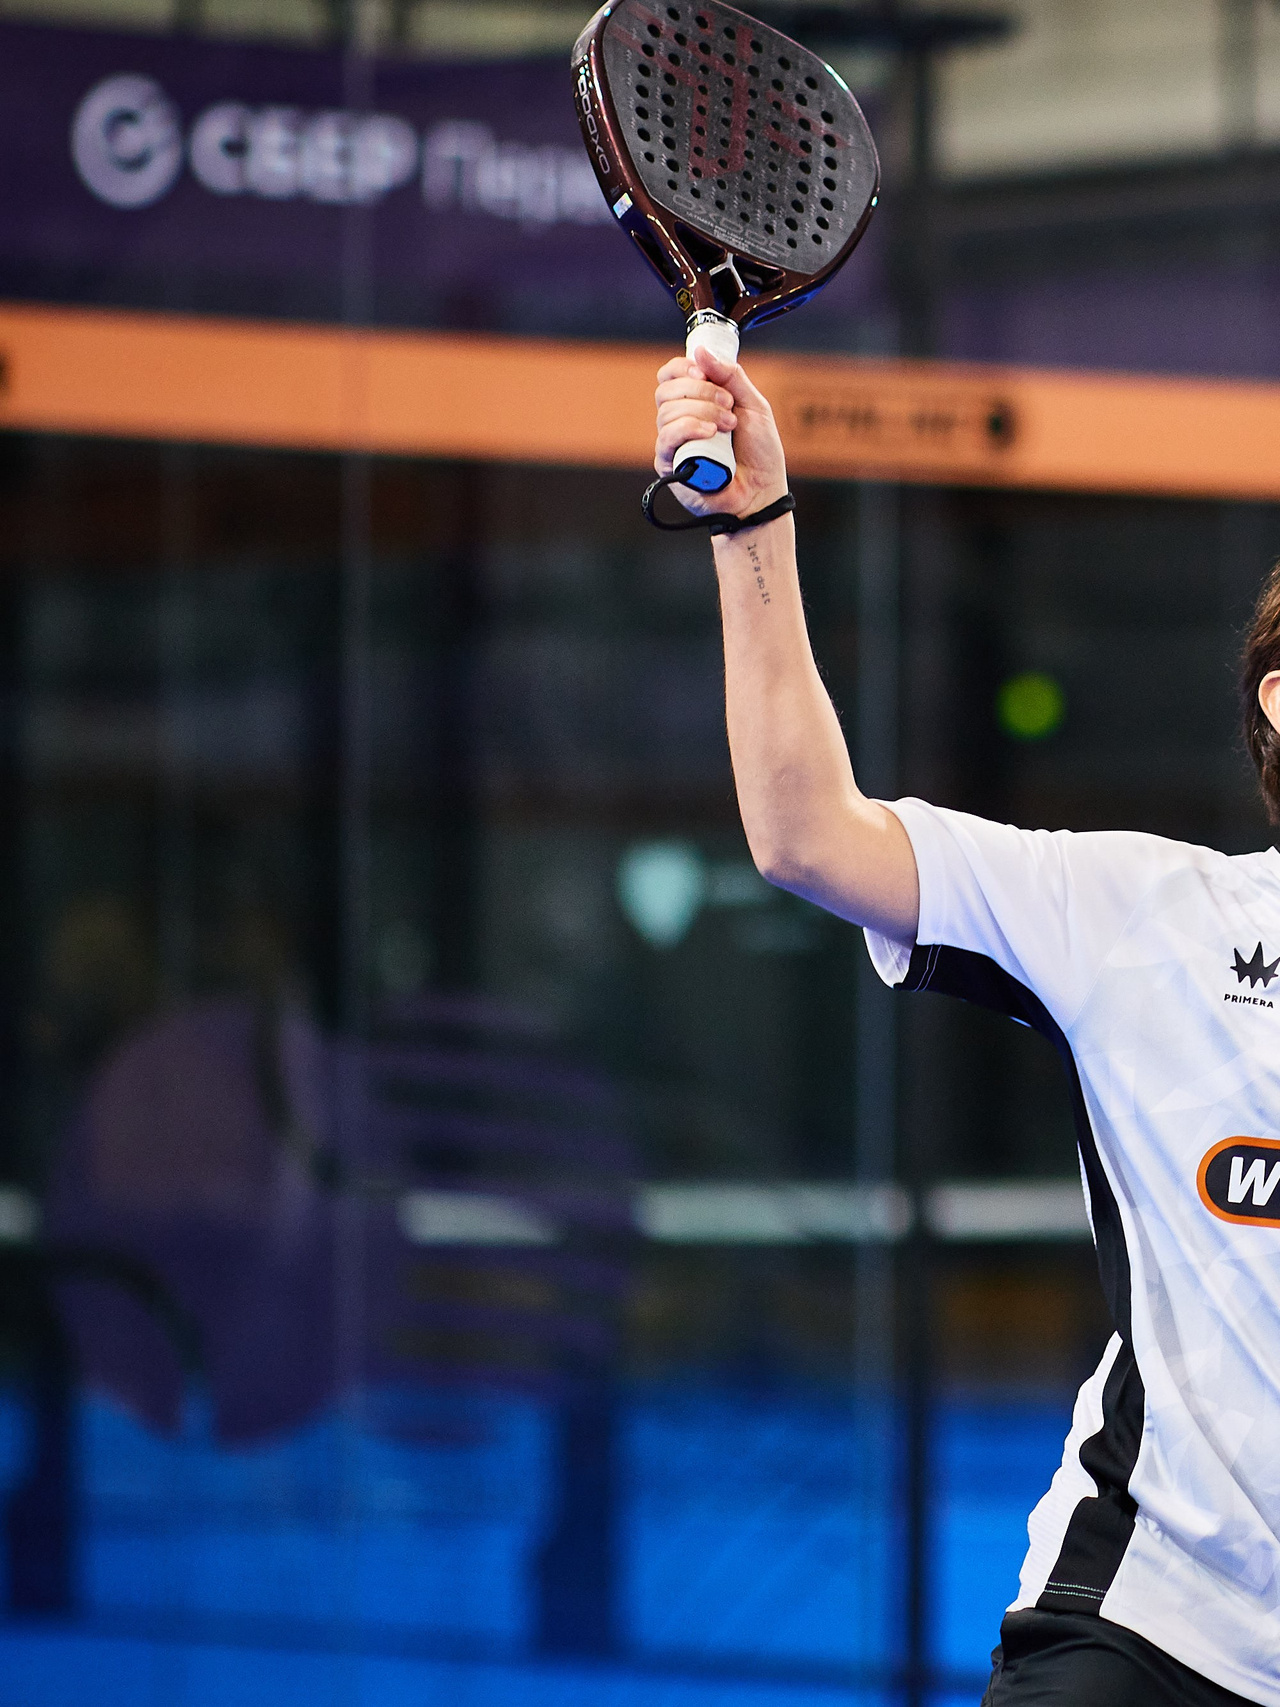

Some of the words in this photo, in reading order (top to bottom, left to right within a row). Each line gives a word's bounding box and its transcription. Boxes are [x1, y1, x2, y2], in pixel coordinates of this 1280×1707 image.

[192, 104, 416, 201] СБЕР
[757, 576, 765, 590] do
[762, 592, 771, 605] it
[1223, 993, 1274, 1009] PRIMERA
